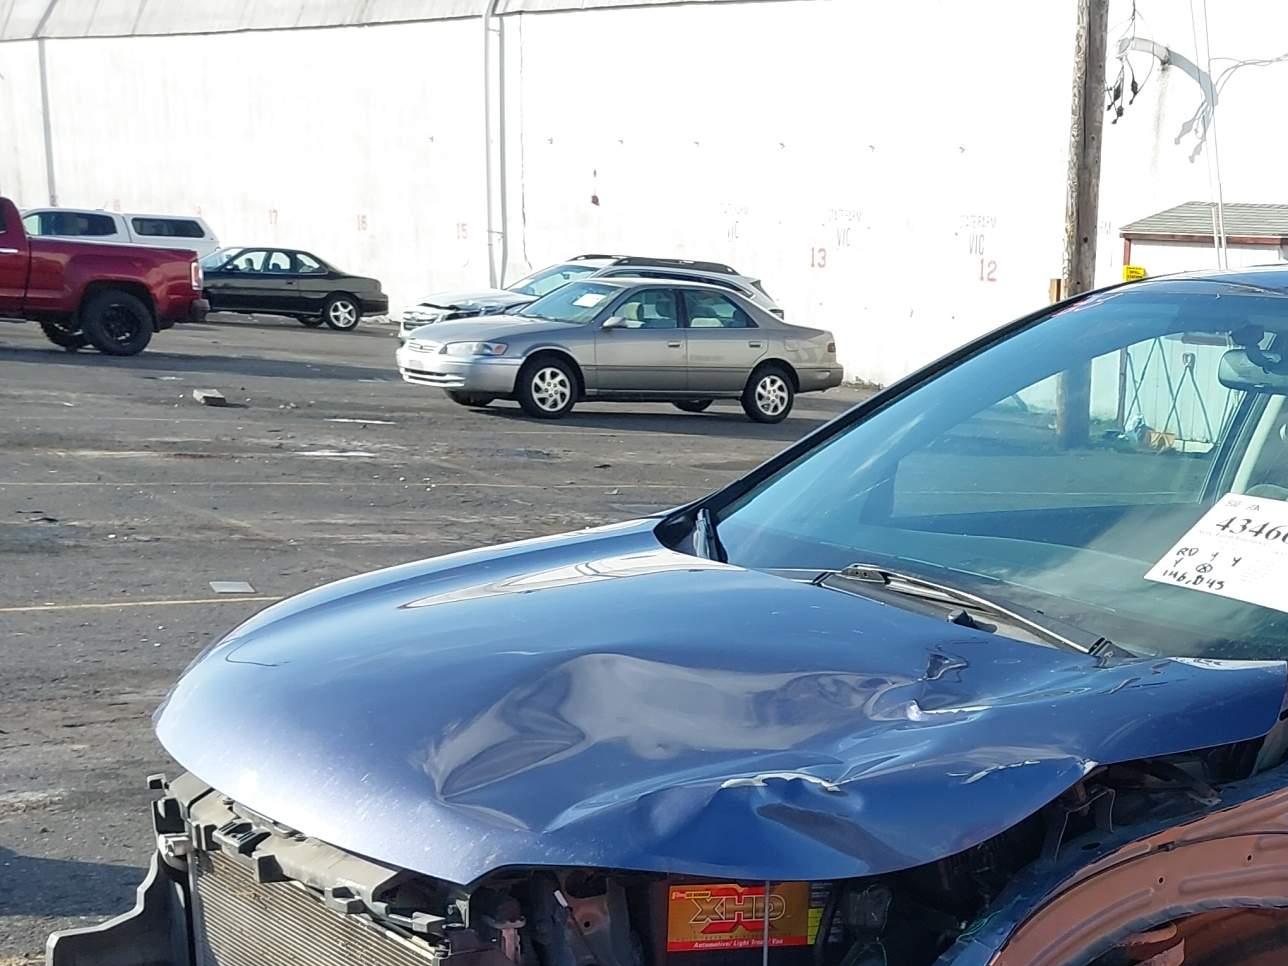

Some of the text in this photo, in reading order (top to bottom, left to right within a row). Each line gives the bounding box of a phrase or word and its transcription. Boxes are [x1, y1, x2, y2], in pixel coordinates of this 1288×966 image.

[456, 223, 468, 240] 15
[836, 227, 852, 248] VIC
[968, 232, 985, 256] VIC
[809, 247, 828, 269] 13
[979, 258, 998, 283] 12
[688, 894, 786, 924] XHD
